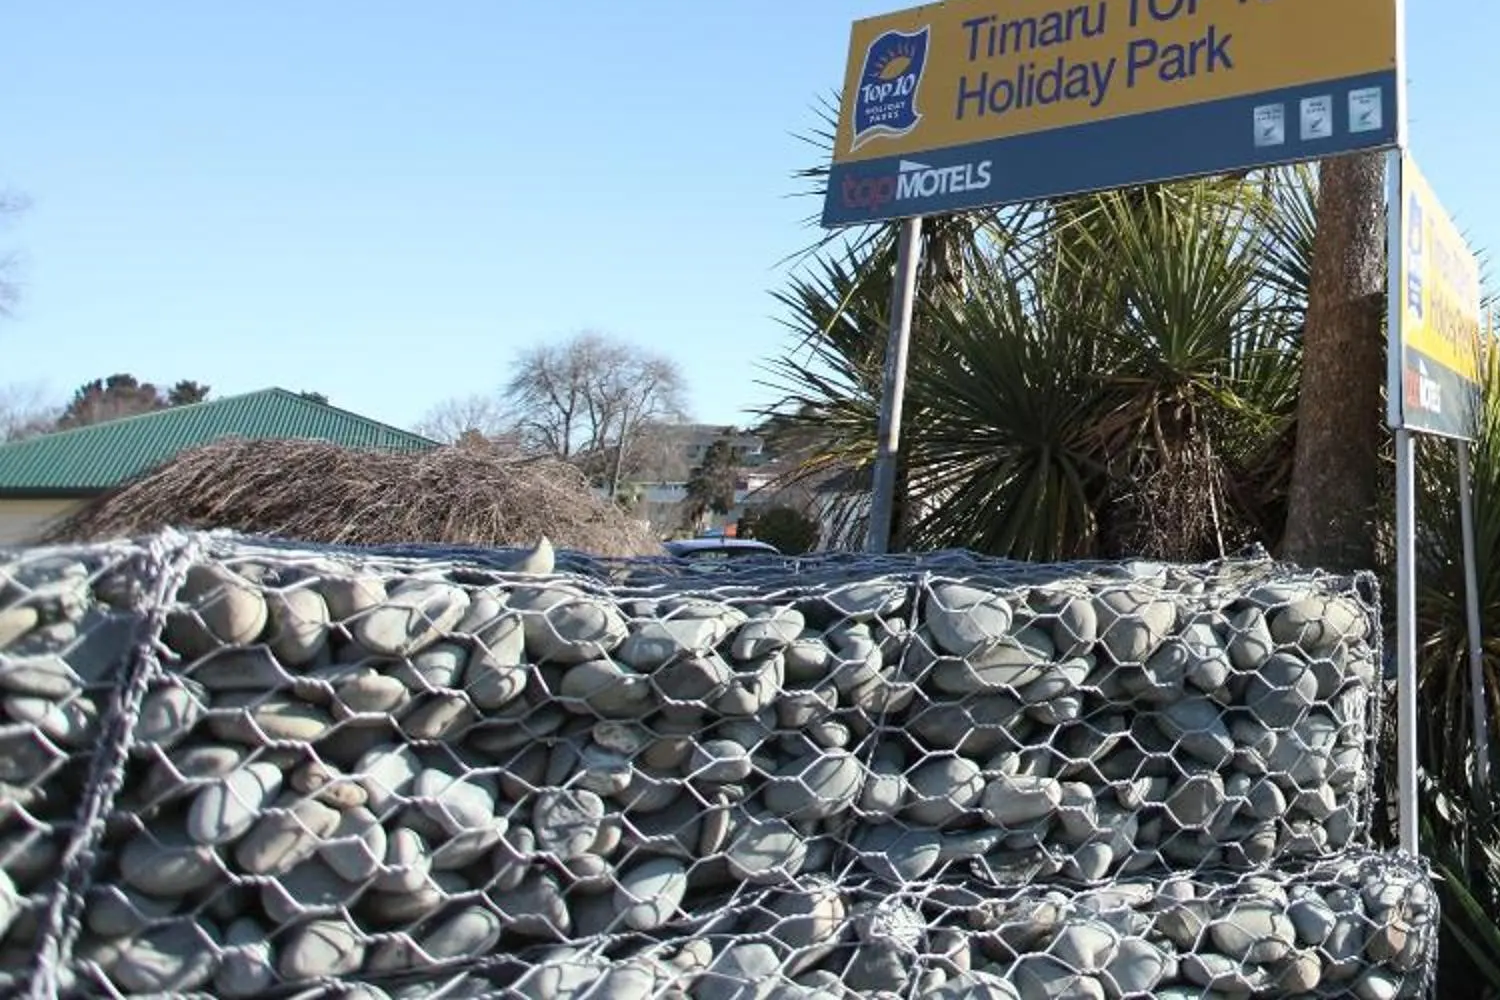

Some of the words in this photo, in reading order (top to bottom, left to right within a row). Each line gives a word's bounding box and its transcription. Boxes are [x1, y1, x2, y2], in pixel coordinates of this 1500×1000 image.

[962, 2, 1106, 61] Timaru
[956, 57, 1117, 120] Holiday
[1127, 25, 1233, 88] Park
